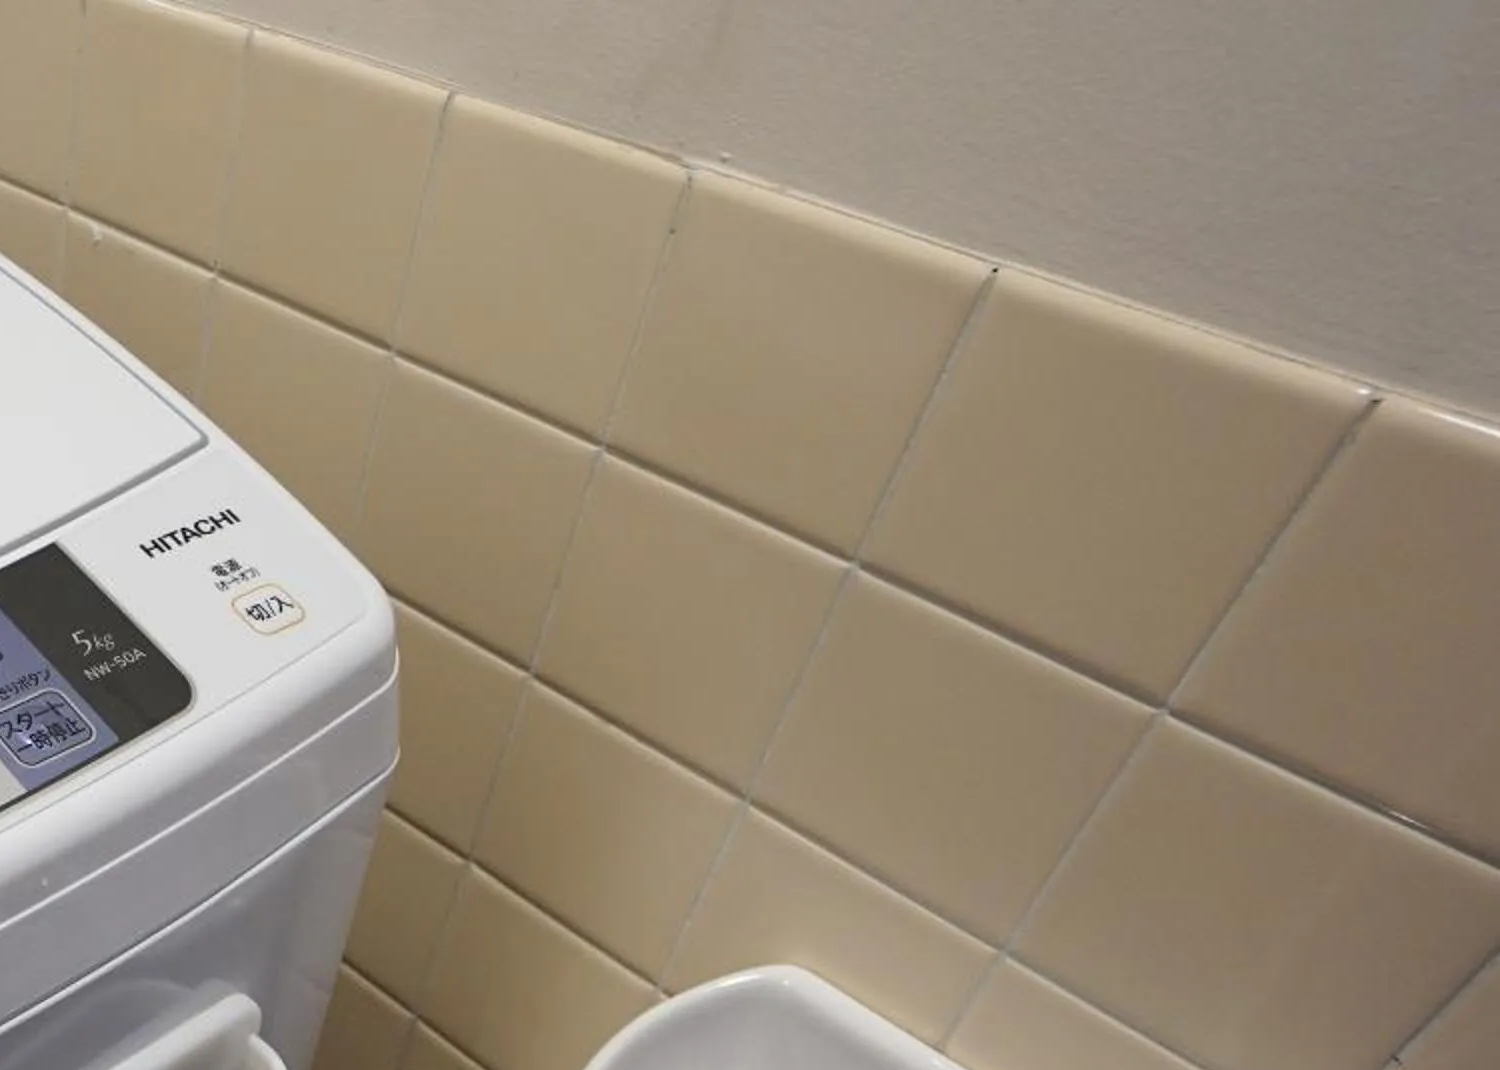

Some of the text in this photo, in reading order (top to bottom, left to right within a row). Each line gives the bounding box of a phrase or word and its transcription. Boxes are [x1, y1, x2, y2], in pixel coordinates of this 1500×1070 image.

[140, 508, 242, 558] HITACHI
[83, 647, 147, 682] NW-50A
[0, 700, 66, 740] スタート
[16, 716, 87, 754] 一時停止
